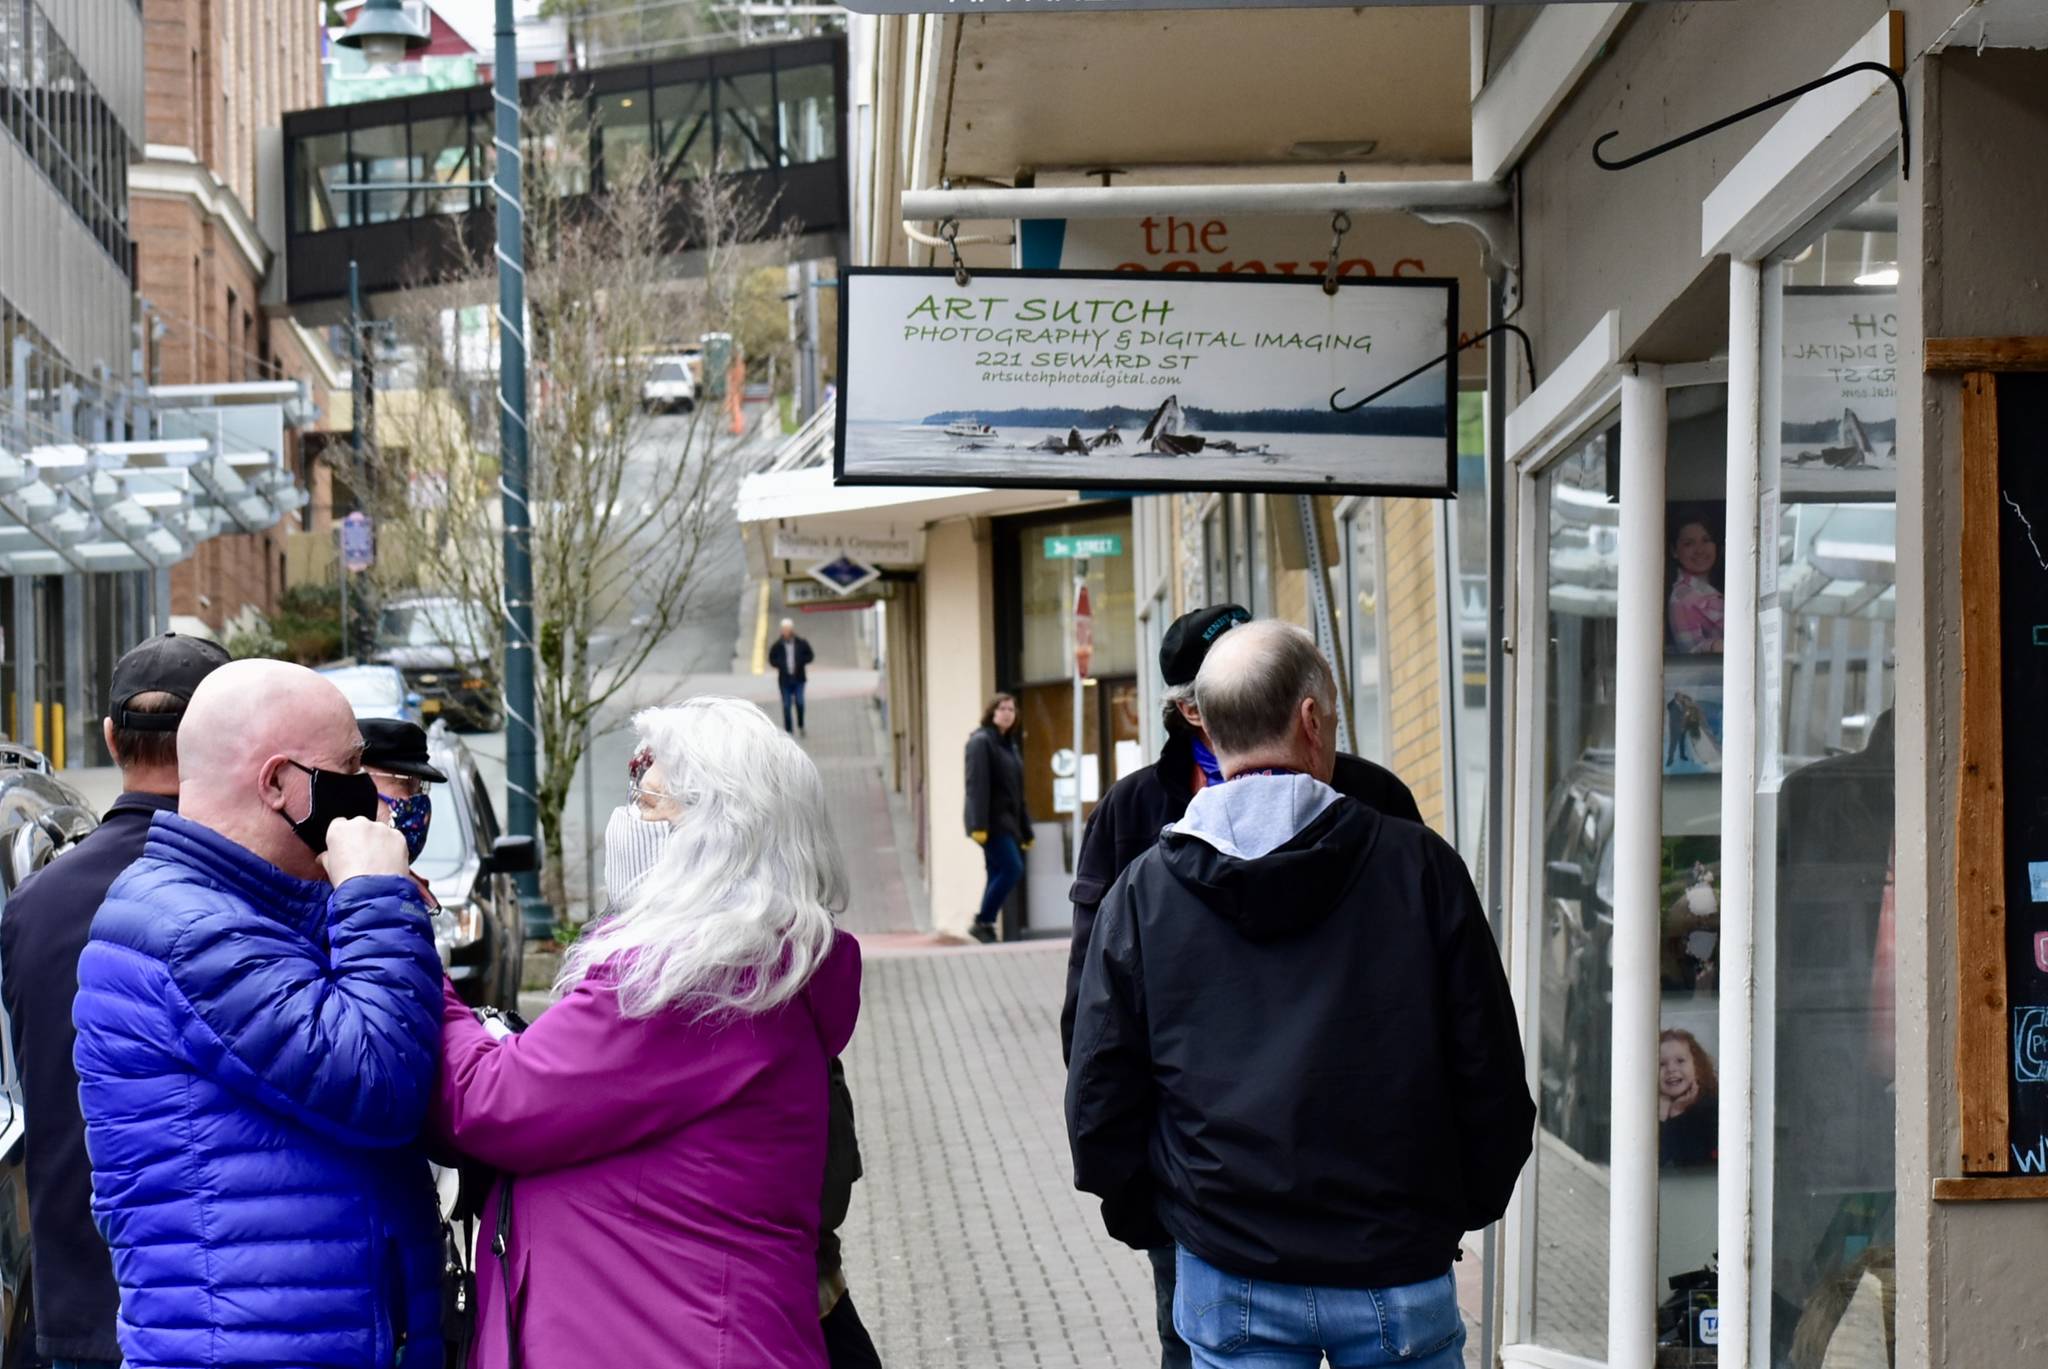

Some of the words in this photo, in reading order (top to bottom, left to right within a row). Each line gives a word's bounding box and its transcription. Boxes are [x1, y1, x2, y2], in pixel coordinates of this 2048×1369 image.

[1139, 215, 1229, 255] the
[906, 294, 1009, 321] ART
[1014, 298, 1175, 326] SUTCH
[903, 325, 1110, 352] PHOTOGRAPHY
[1113, 329, 1132, 351] &
[1139, 330, 1247, 350] DIGITAL
[1254, 331, 1373, 354] IMAGING
[975, 351, 1024, 367] 221
[1030, 352, 1152, 370] SEWARD
[1157, 354, 1199, 370] ST
[981, 370, 1183, 389] artsutchphotodigital.com
